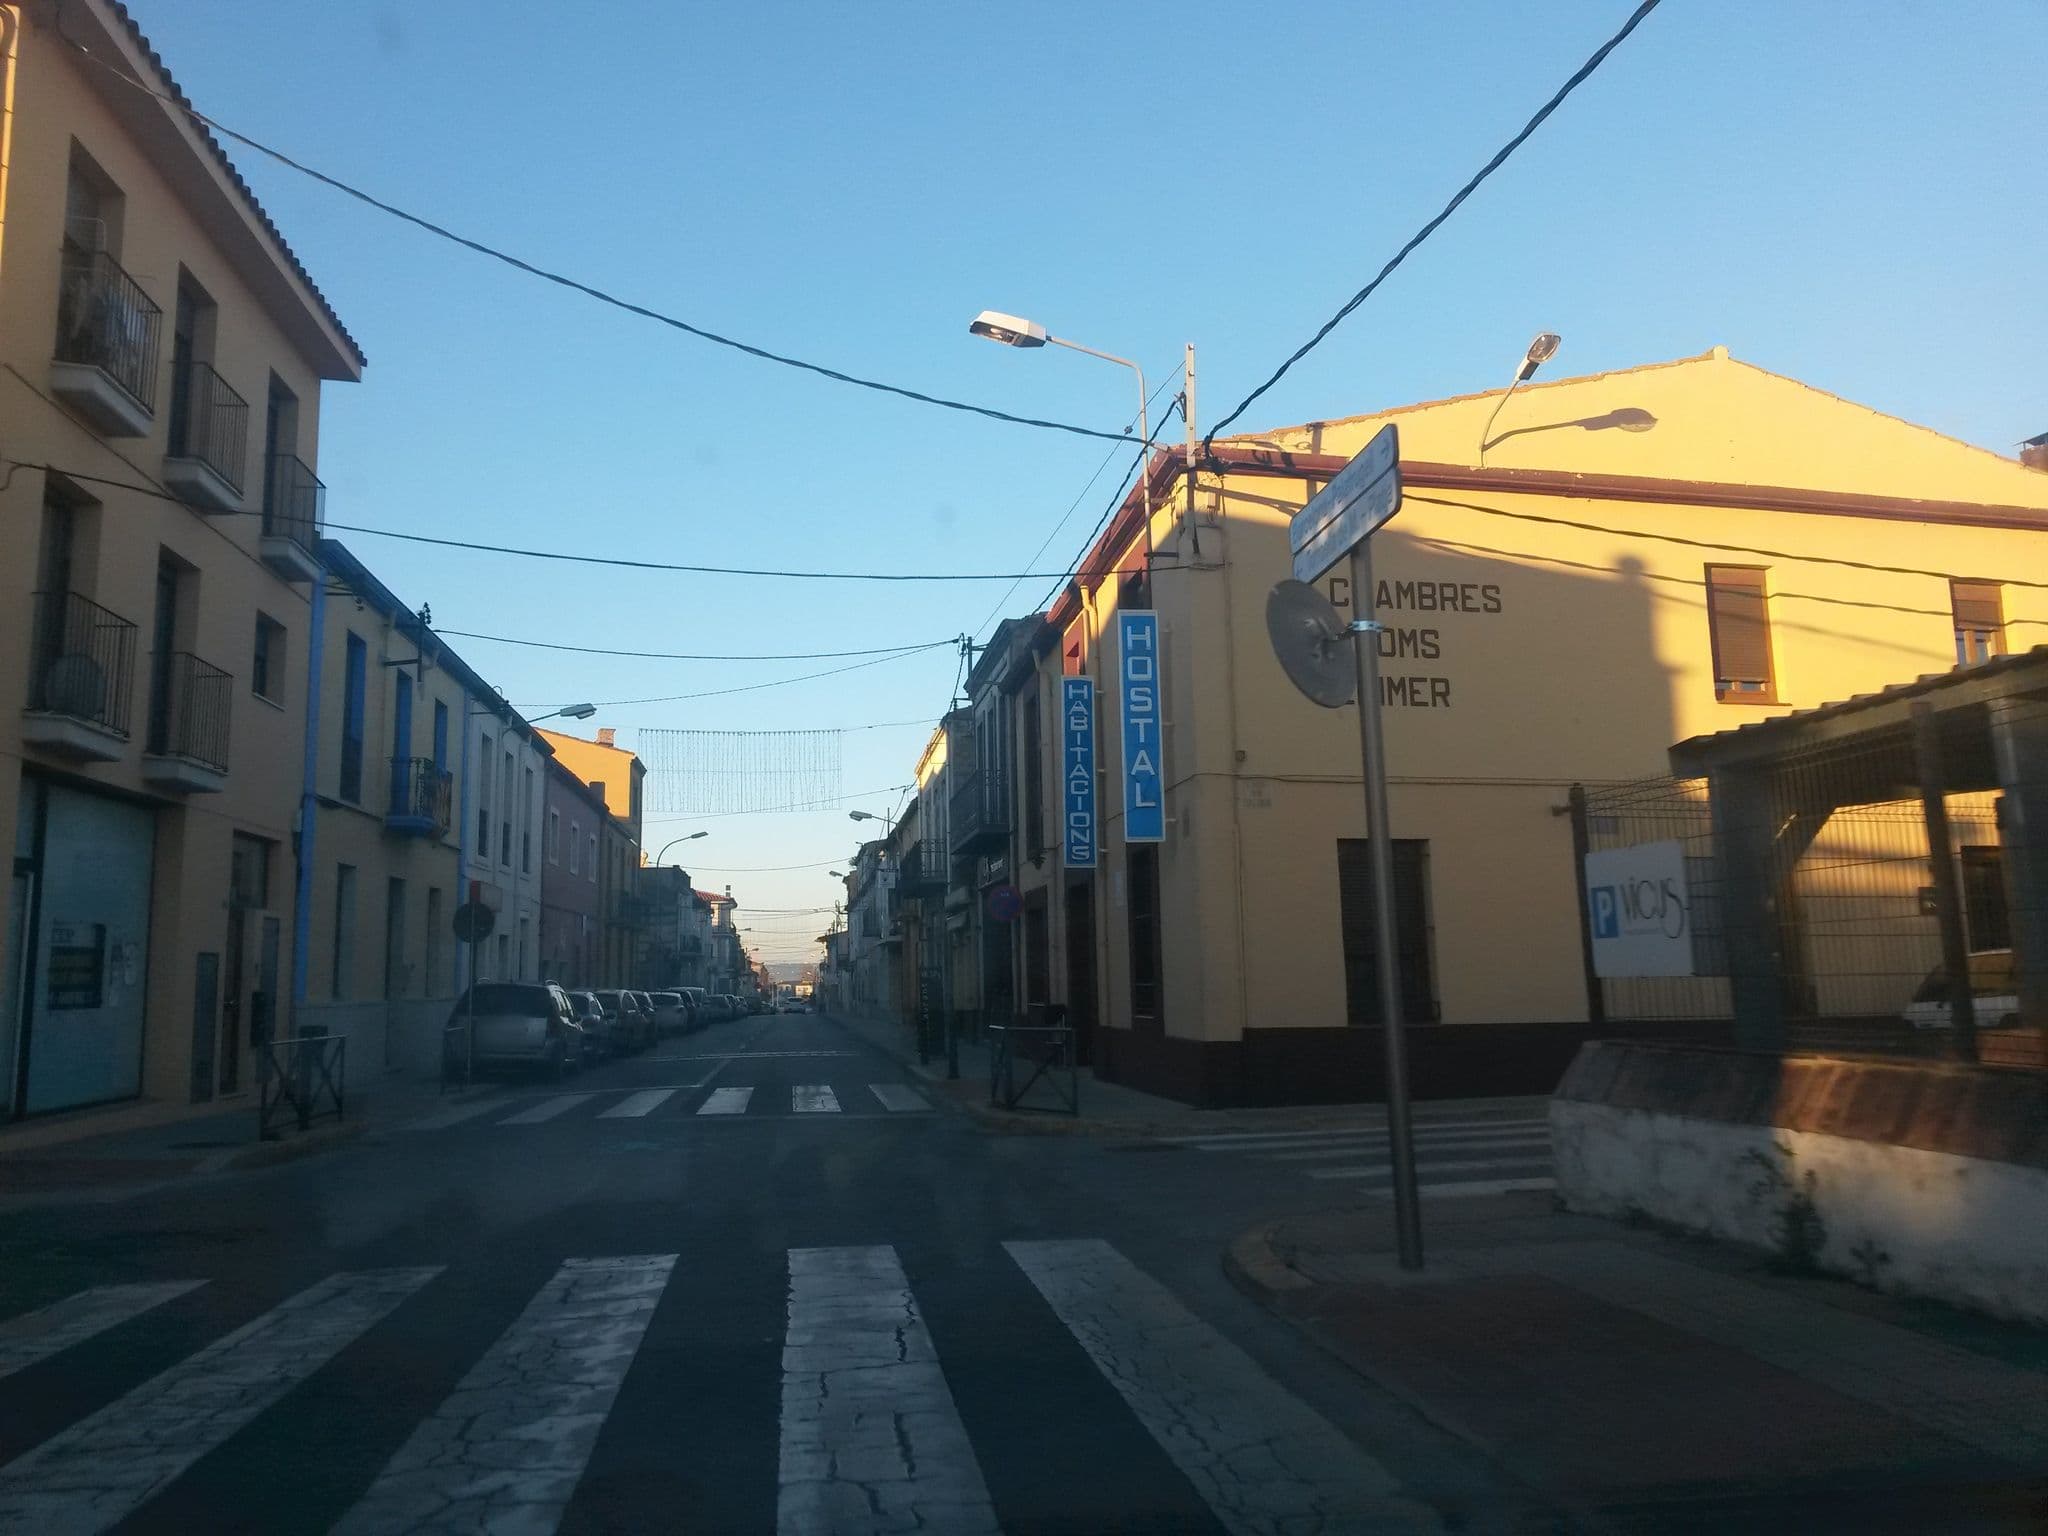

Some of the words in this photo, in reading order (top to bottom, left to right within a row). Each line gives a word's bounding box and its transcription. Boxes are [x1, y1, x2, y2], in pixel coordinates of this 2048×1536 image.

[1329, 577, 1502, 613] CAMBRES
[1126, 625, 1156, 808] HOSTAL
[1068, 684, 1091, 861] HABITACIONS
[1597, 890, 1613, 936] P
